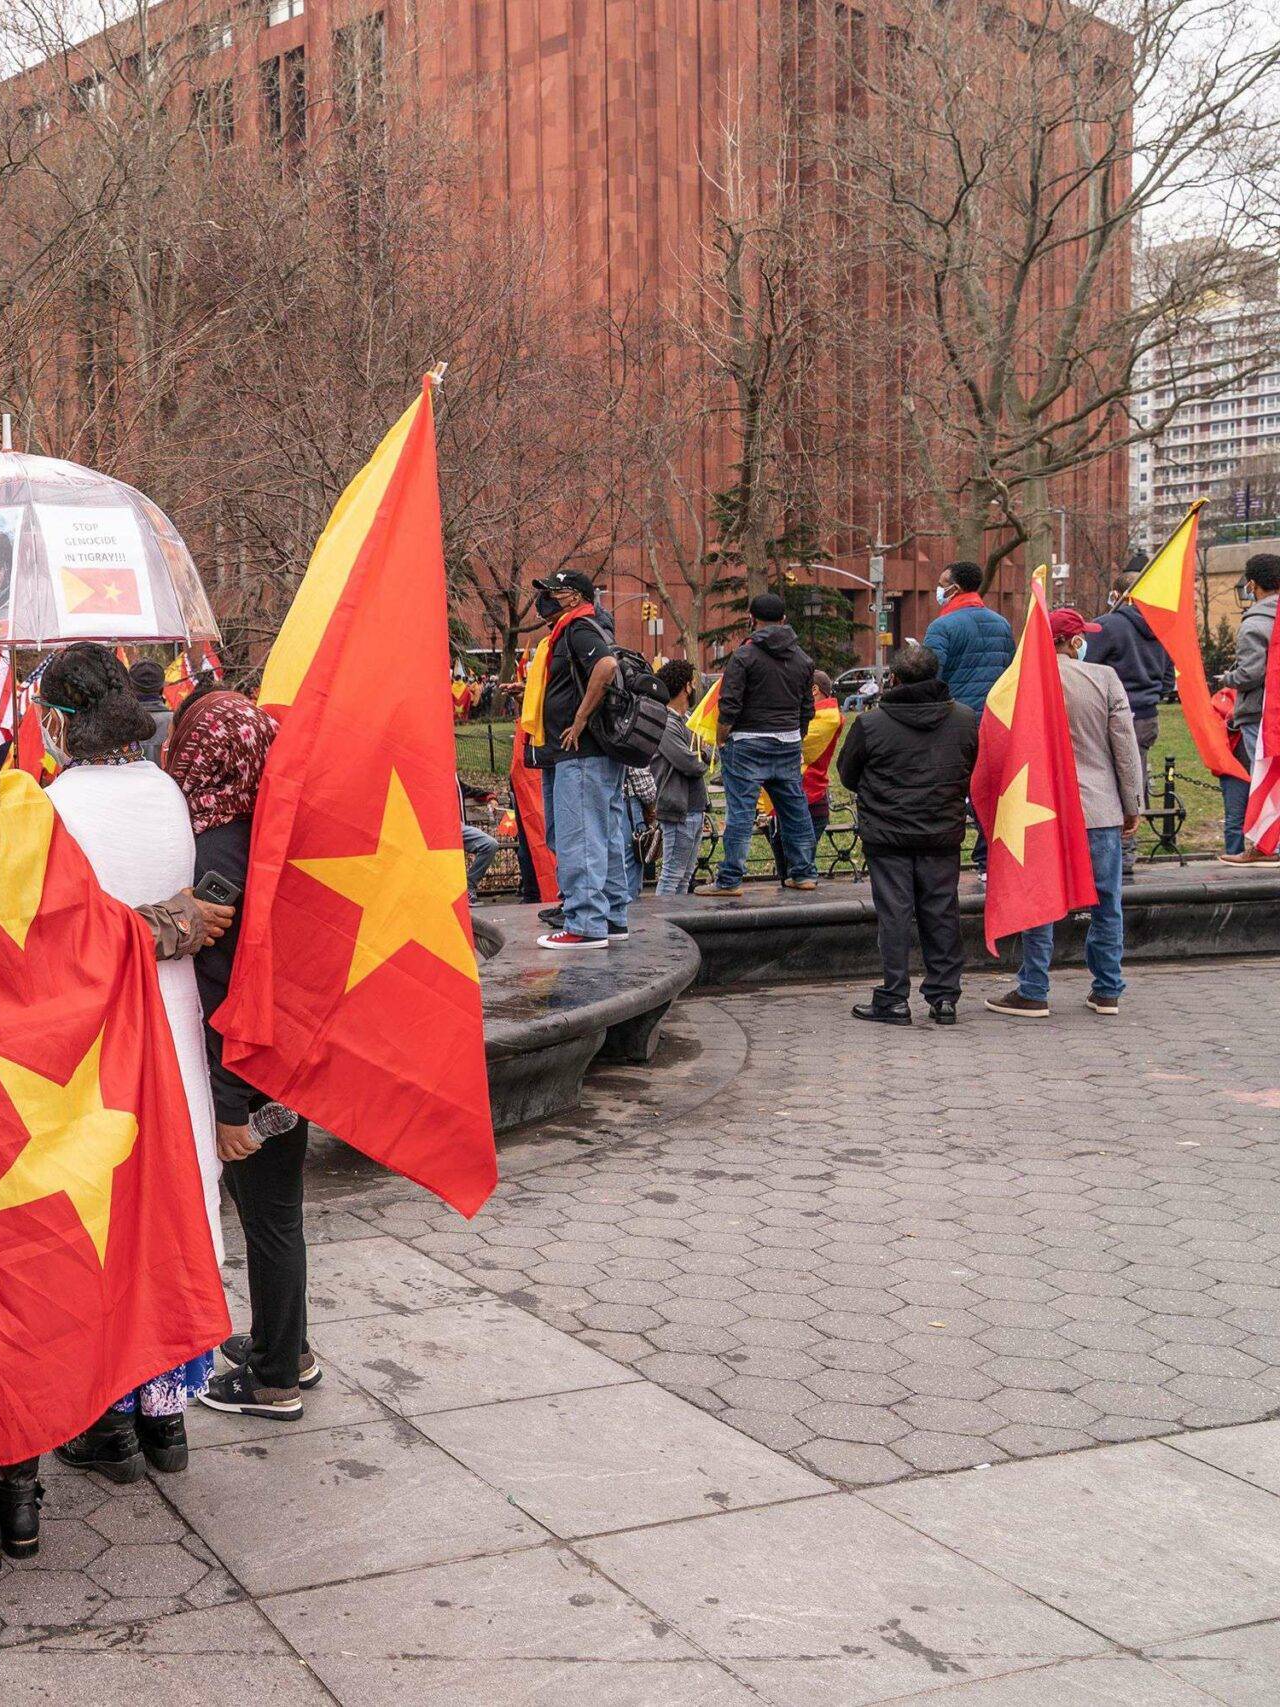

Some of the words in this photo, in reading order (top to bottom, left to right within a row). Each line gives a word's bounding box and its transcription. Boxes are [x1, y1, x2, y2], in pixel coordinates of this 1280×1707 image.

[72, 522, 99, 532] STOP
[64, 536, 118, 546] GENOCIDE
[64, 554, 76, 563] IN
[78, 552, 127, 563] TIGRAY!!!
